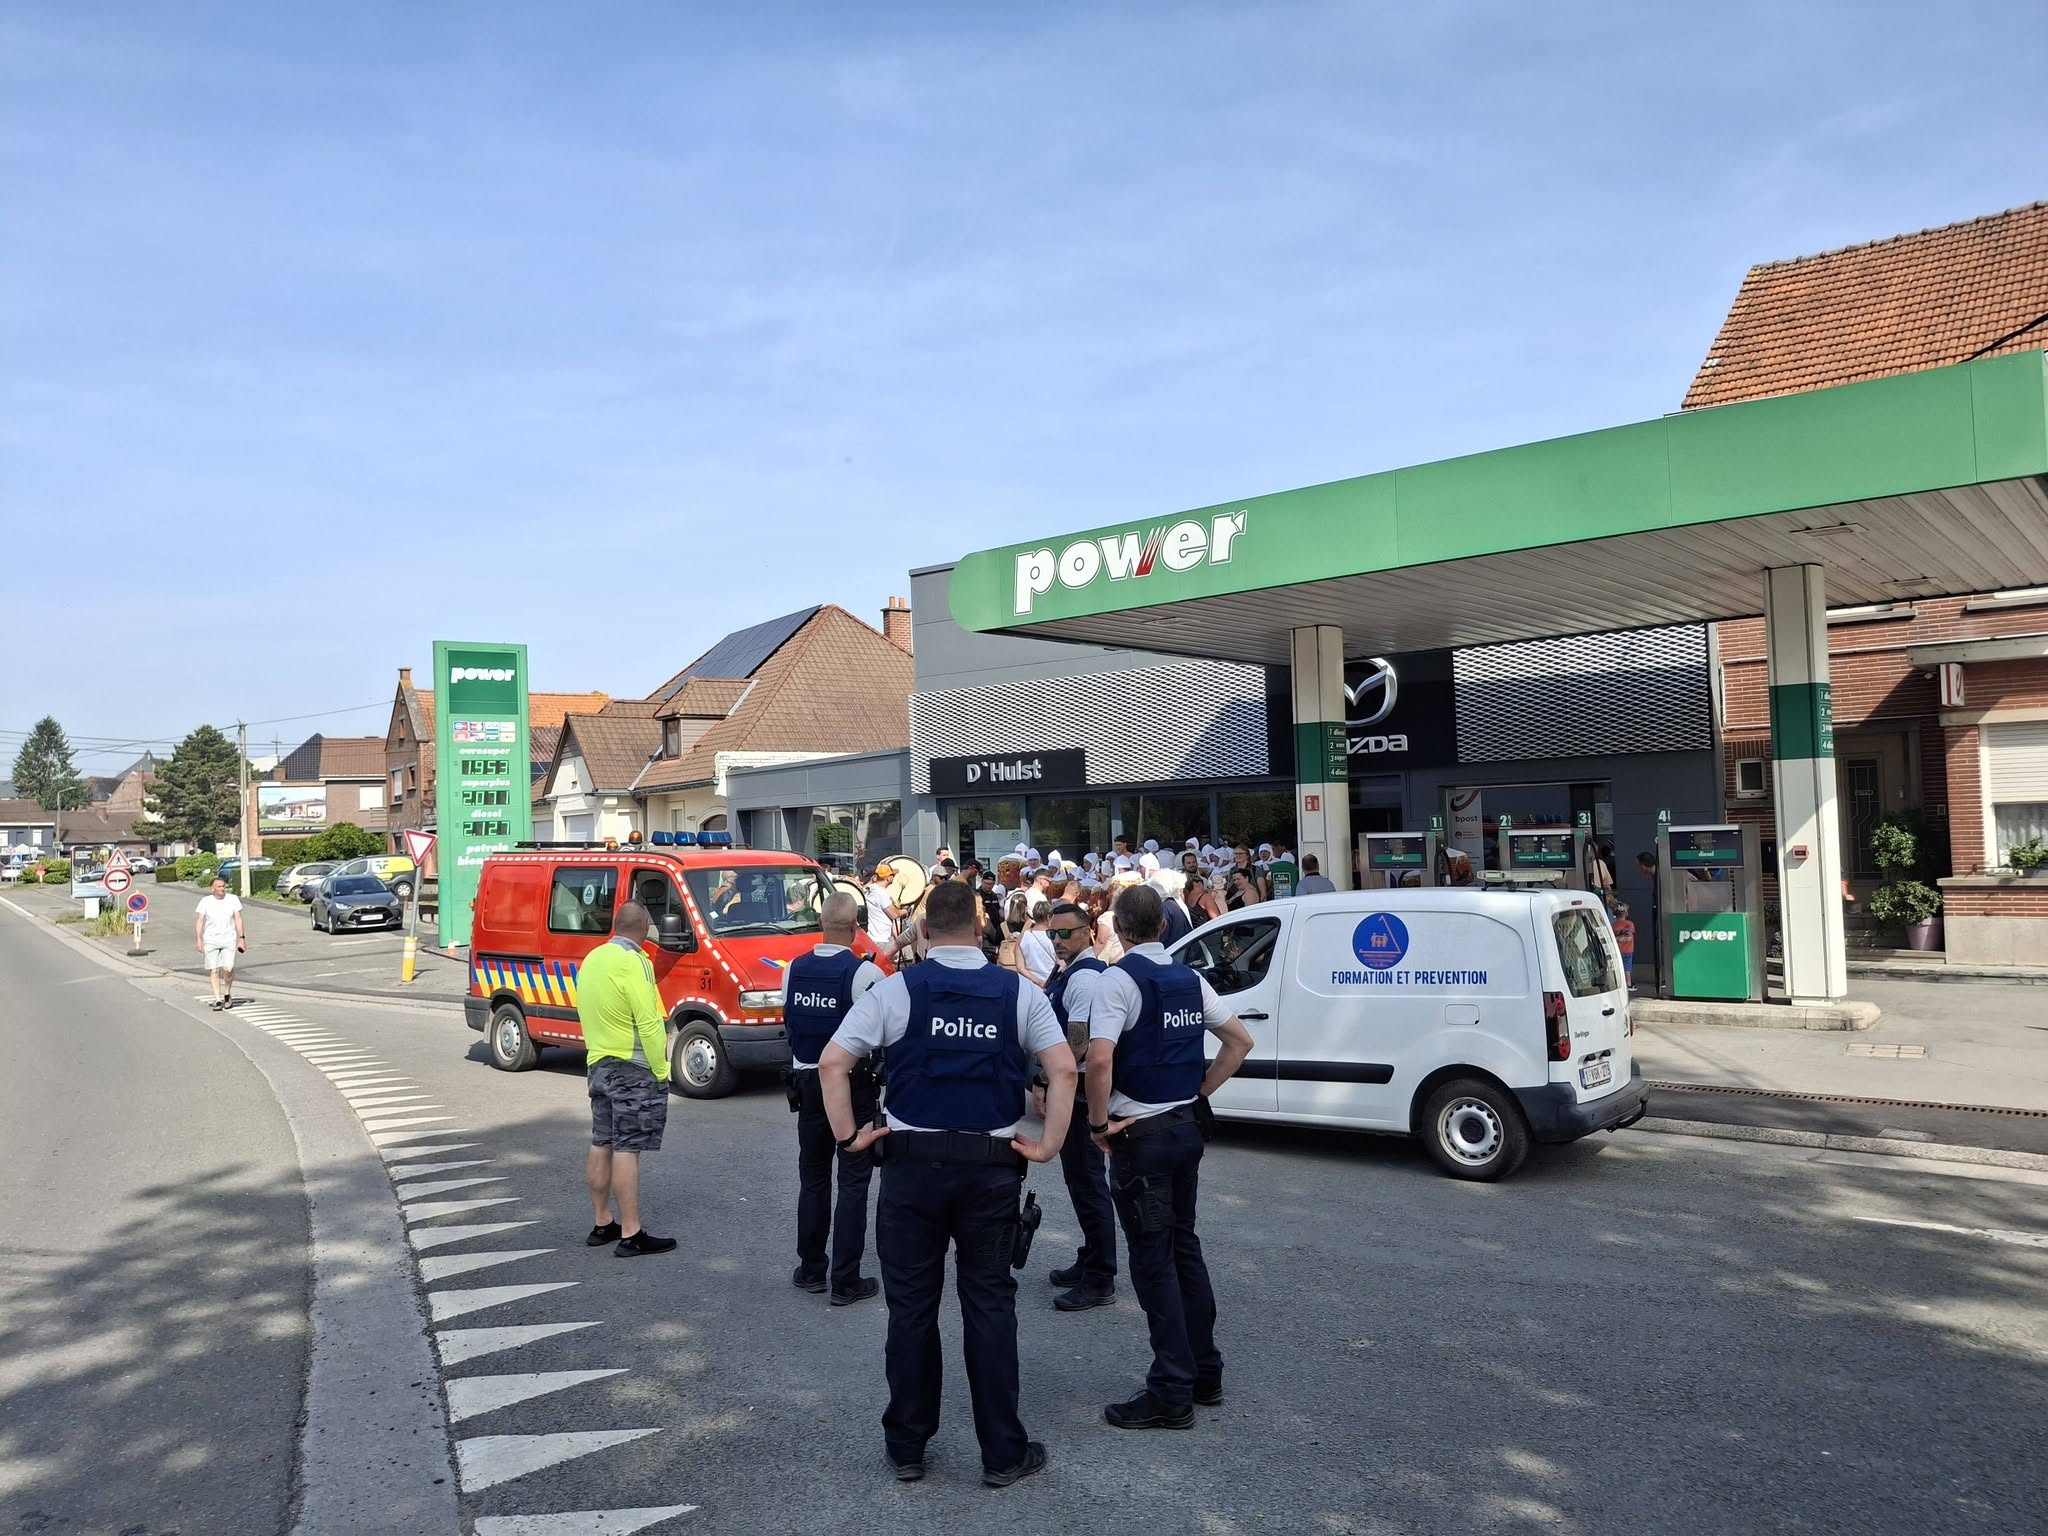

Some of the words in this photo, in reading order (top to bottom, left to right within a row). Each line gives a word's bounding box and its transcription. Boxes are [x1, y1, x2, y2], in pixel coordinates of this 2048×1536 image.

[1013, 509, 1248, 616] power
[450, 667, 516, 684] power
[468, 760, 508, 775] 1.953
[463, 791, 509, 806] 2.071
[471, 808, 502, 818] diesel
[1455, 815, 1478, 823] bpost
[1579, 813, 1587, 824] 3
[1658, 810, 1667, 822] 4
[464, 821, 510, 836] 2.127
[1500, 815, 1508, 827] 2
[1678, 929, 1737, 943] power
[700, 977, 712, 991] 31
[1331, 970, 1393, 985] FORMATION
[1396, 970, 1410, 985] ET
[1414, 970, 1488, 985] PREVENTION
[793, 992, 837, 1009] Police
[1163, 1008, 1202, 1029] Police
[930, 1017, 998, 1040] Police
